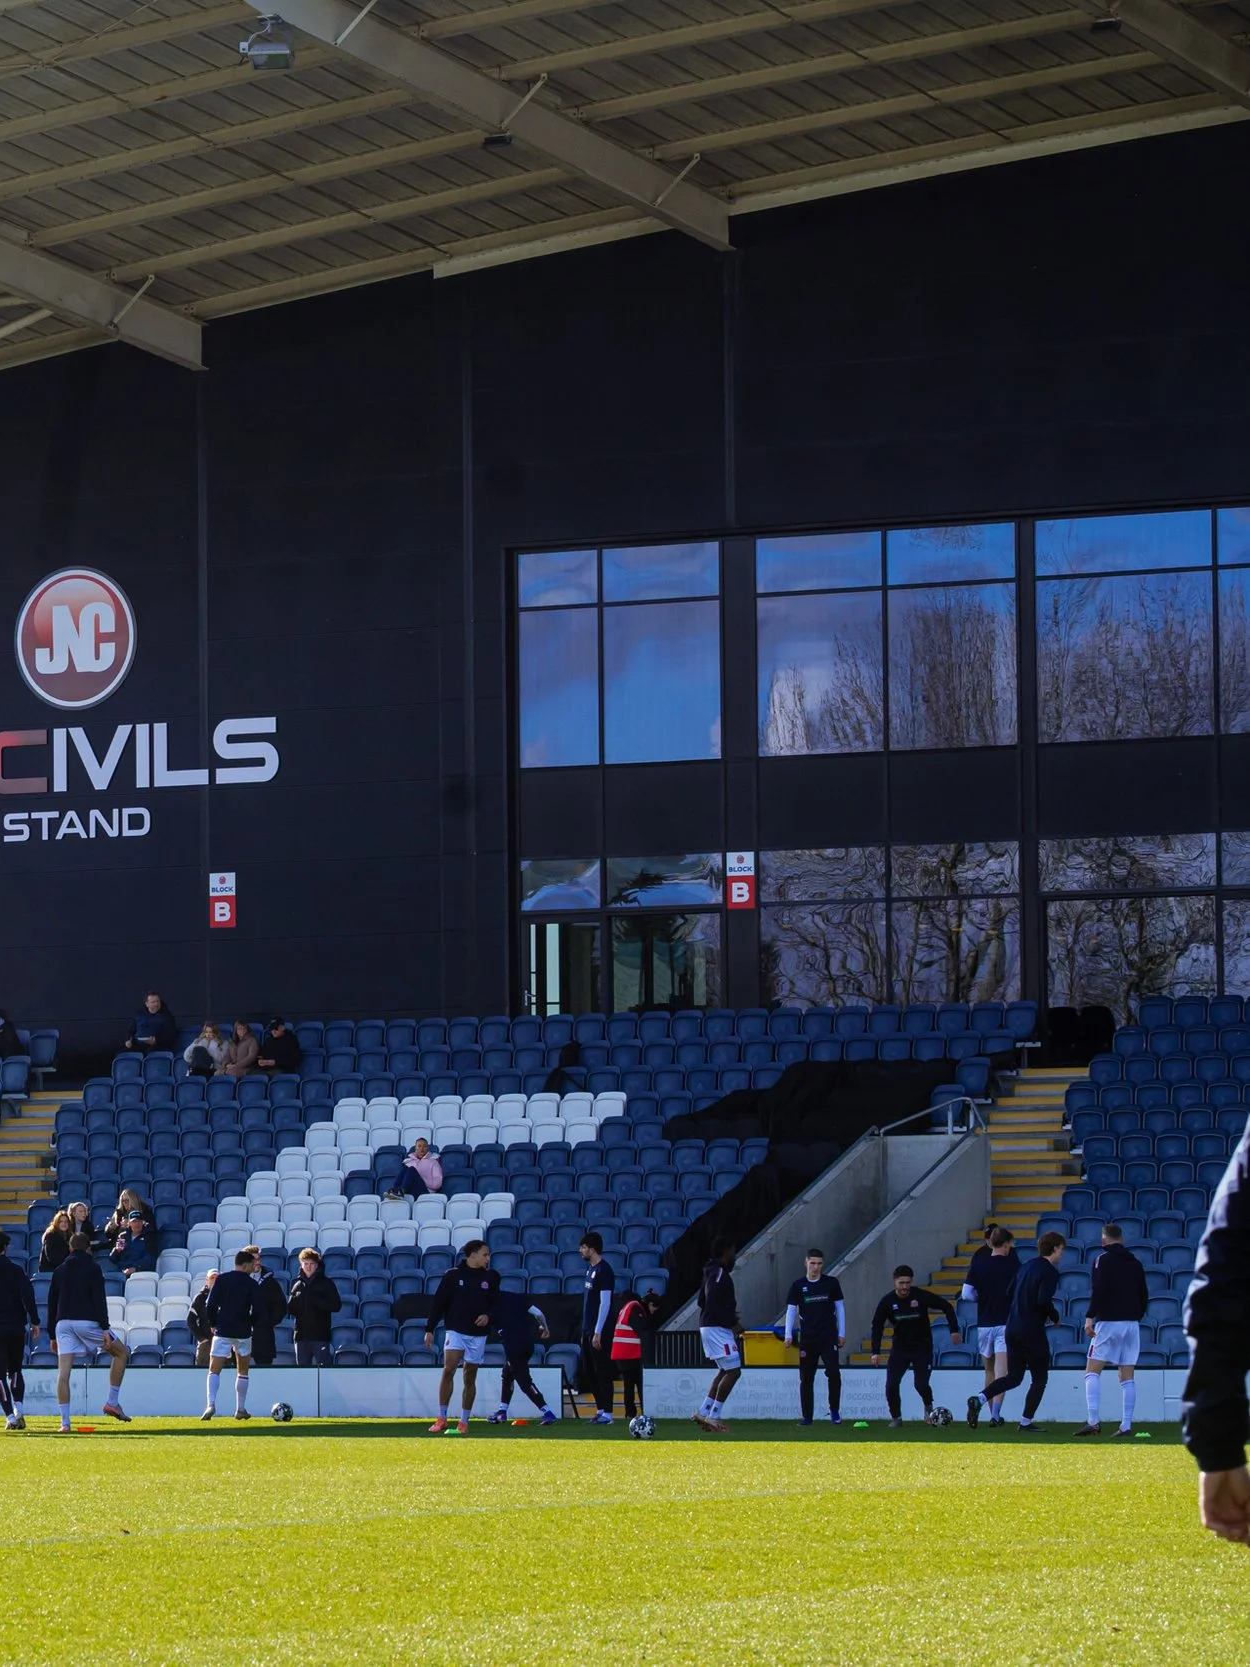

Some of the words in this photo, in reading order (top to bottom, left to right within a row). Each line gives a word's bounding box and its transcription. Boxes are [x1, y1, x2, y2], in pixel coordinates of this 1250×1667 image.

[35, 601, 116, 675] JNC
[3, 807, 151, 843] STAND
[732, 882, 750, 903] B
[215, 902, 231, 922] B
